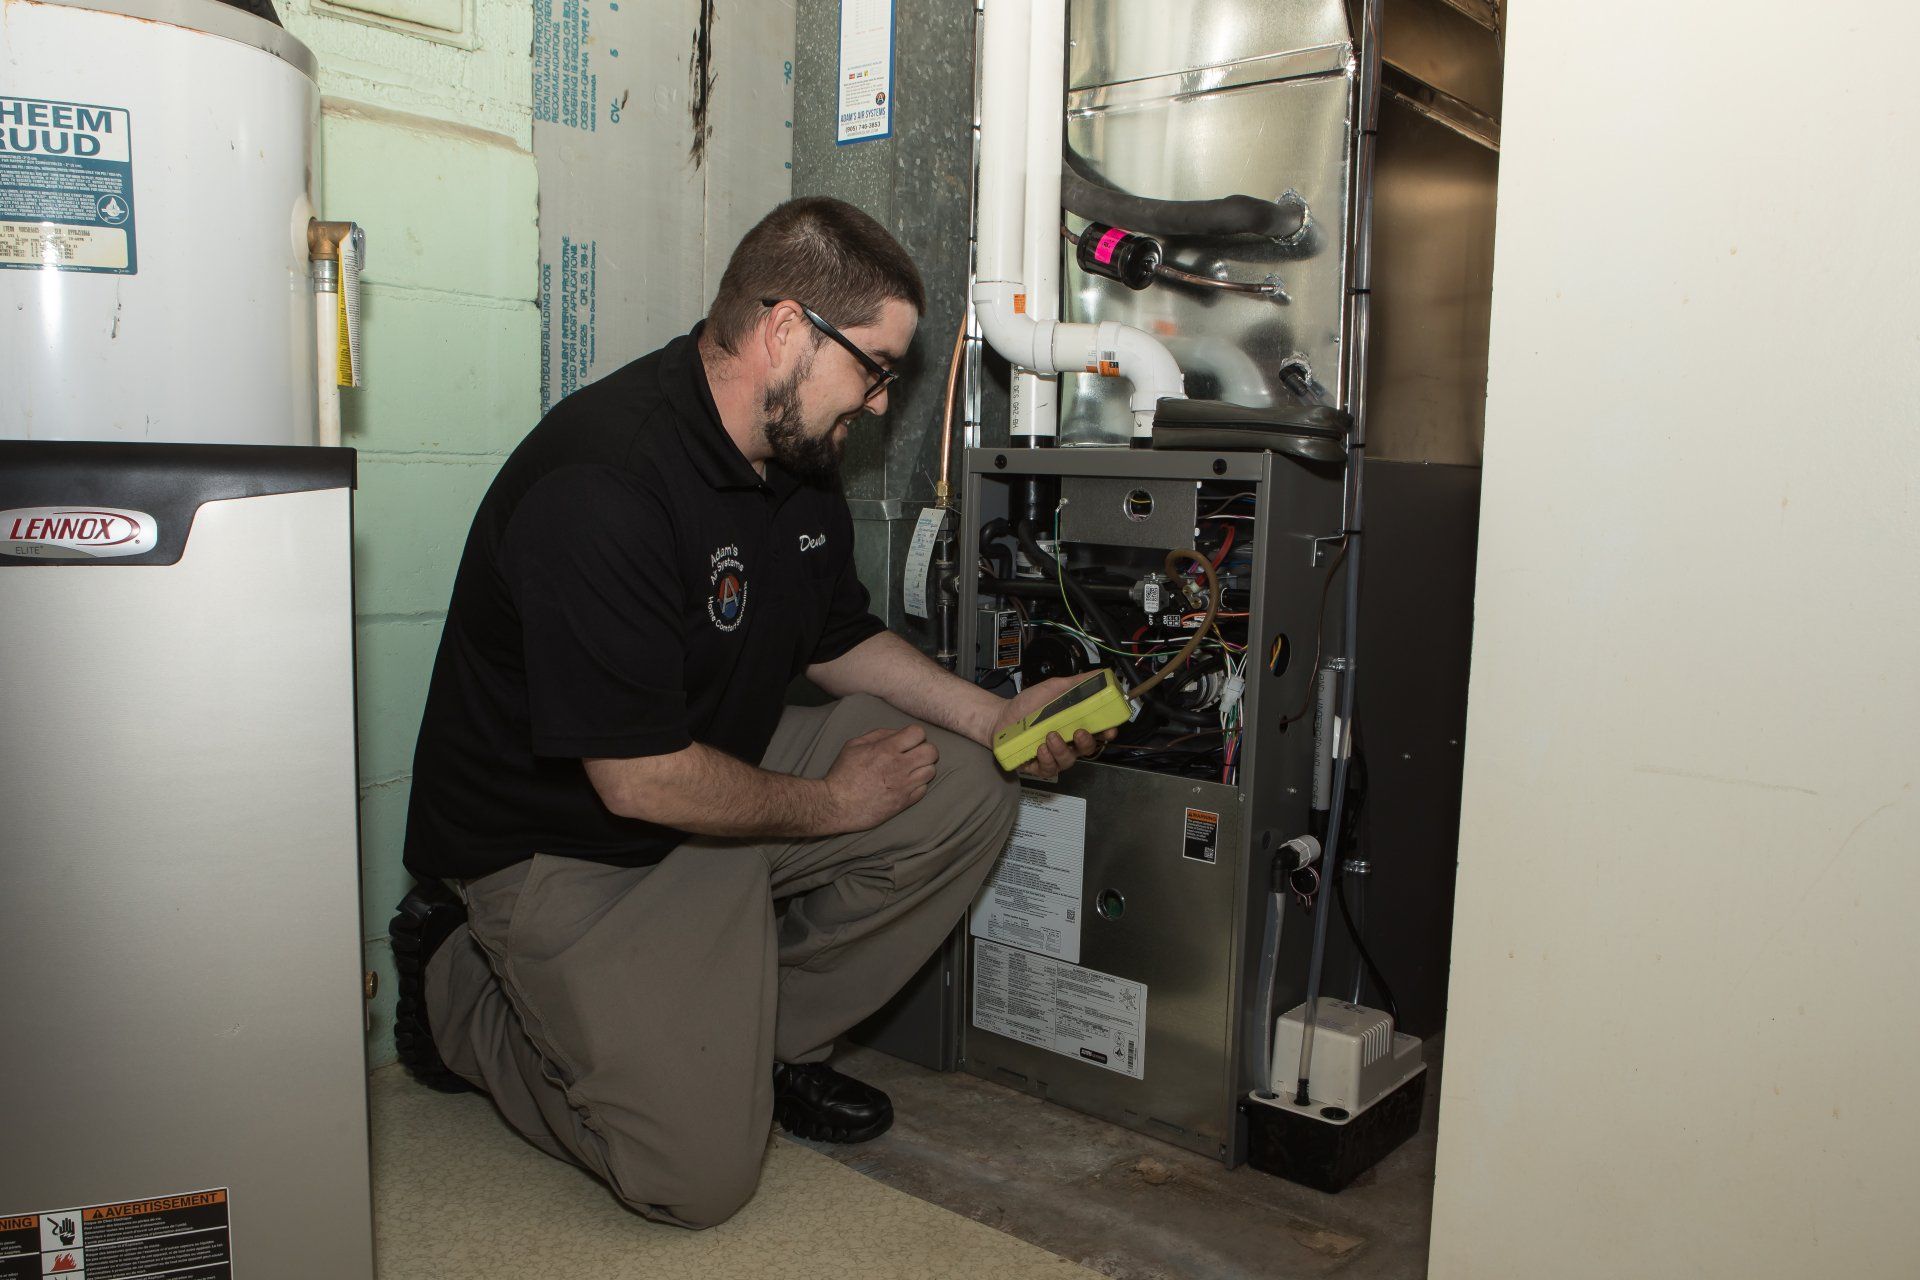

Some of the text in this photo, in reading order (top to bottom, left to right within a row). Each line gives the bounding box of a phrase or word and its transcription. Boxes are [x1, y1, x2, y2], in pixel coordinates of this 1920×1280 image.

[562, 20, 571, 35] OR
[581, 19, 590, 45] TYPE
[534, 0, 544, 120] CAUTION: THIS PRODUC
[562, 37, 571, 71] BOARD
[543, 86, 551, 121] OBTAIN
[562, 75, 570, 115] GYPSUM
[570, 77, 578, 128] COVERING
[562, 118, 570, 126] A
[865, 107, 886, 119] SYSTEMS
[0, 126, 100, 157] UUD
[543, 263, 551, 291] CODE
[569, 313, 577, 341] MOST
[569, 343, 577, 362] FOR
[9, 518, 115, 540] LENNOX
[15, 546, 40, 555] ELITE
[710, 544, 739, 567] Adam's
[717, 557, 744, 572] Systems
[707, 596, 716, 622] Home
[105, 1192, 218, 1217] AVERTISSEMENT
